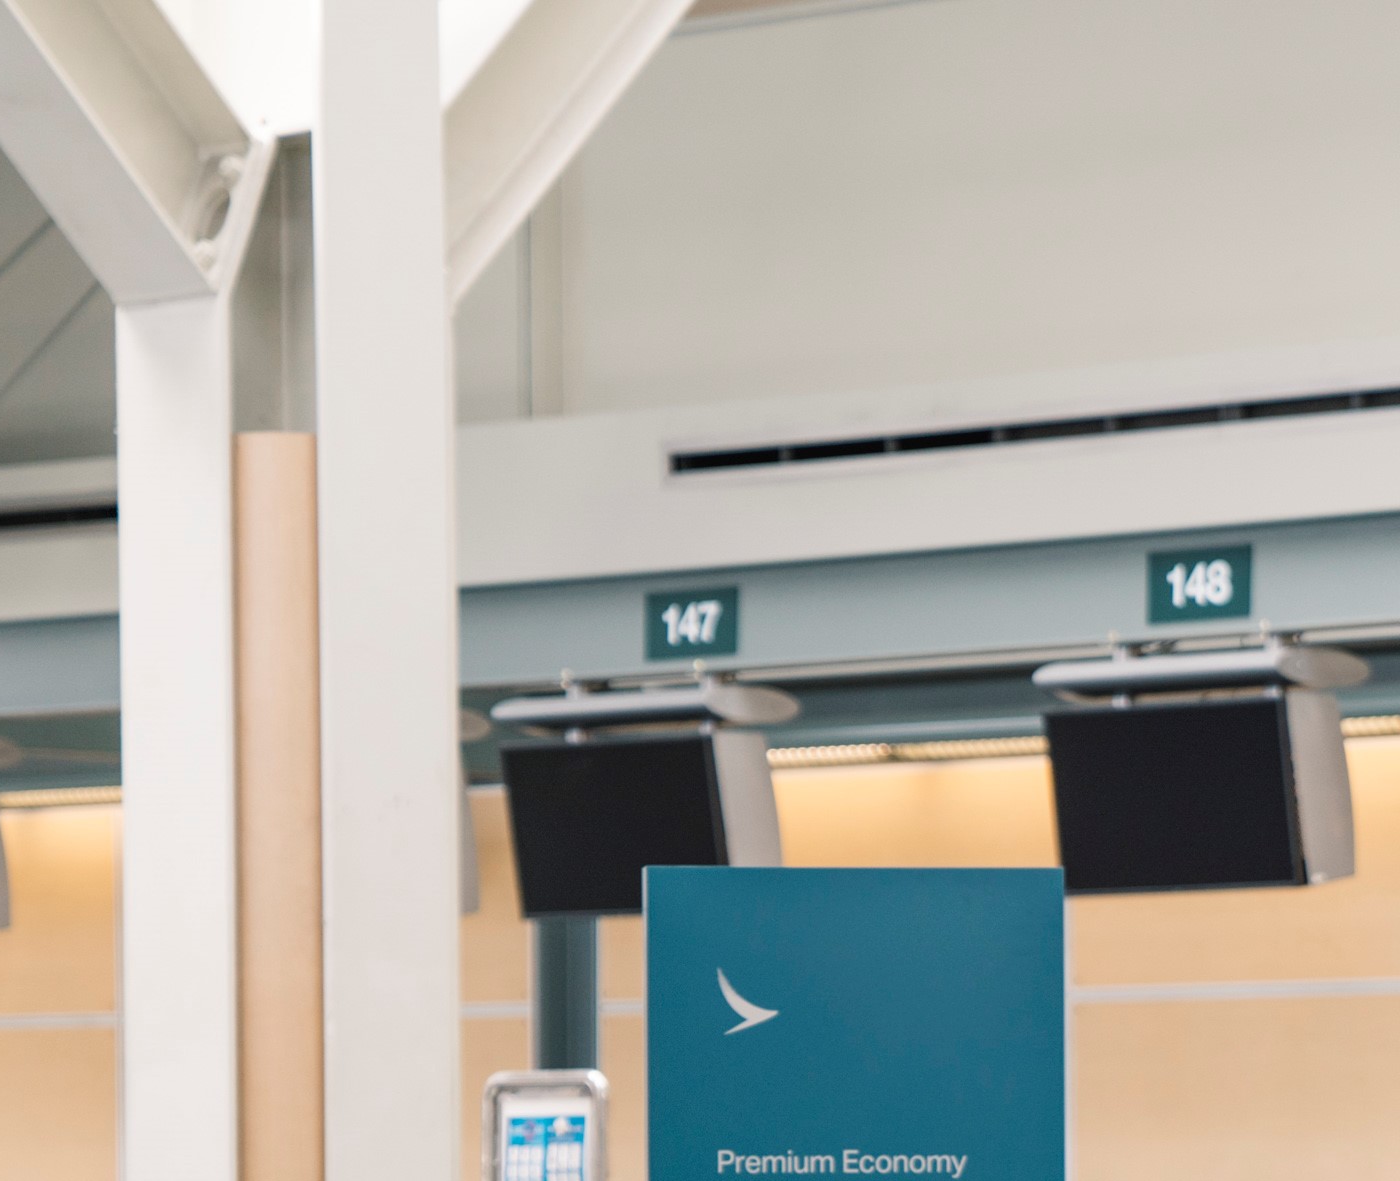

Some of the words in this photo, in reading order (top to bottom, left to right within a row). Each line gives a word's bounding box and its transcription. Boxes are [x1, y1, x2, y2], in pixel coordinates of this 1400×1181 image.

[1166, 559, 1233, 608] 148
[661, 600, 722, 647] 147
[717, 1149, 835, 1174] Premium
[842, 1149, 967, 1179] Economy
